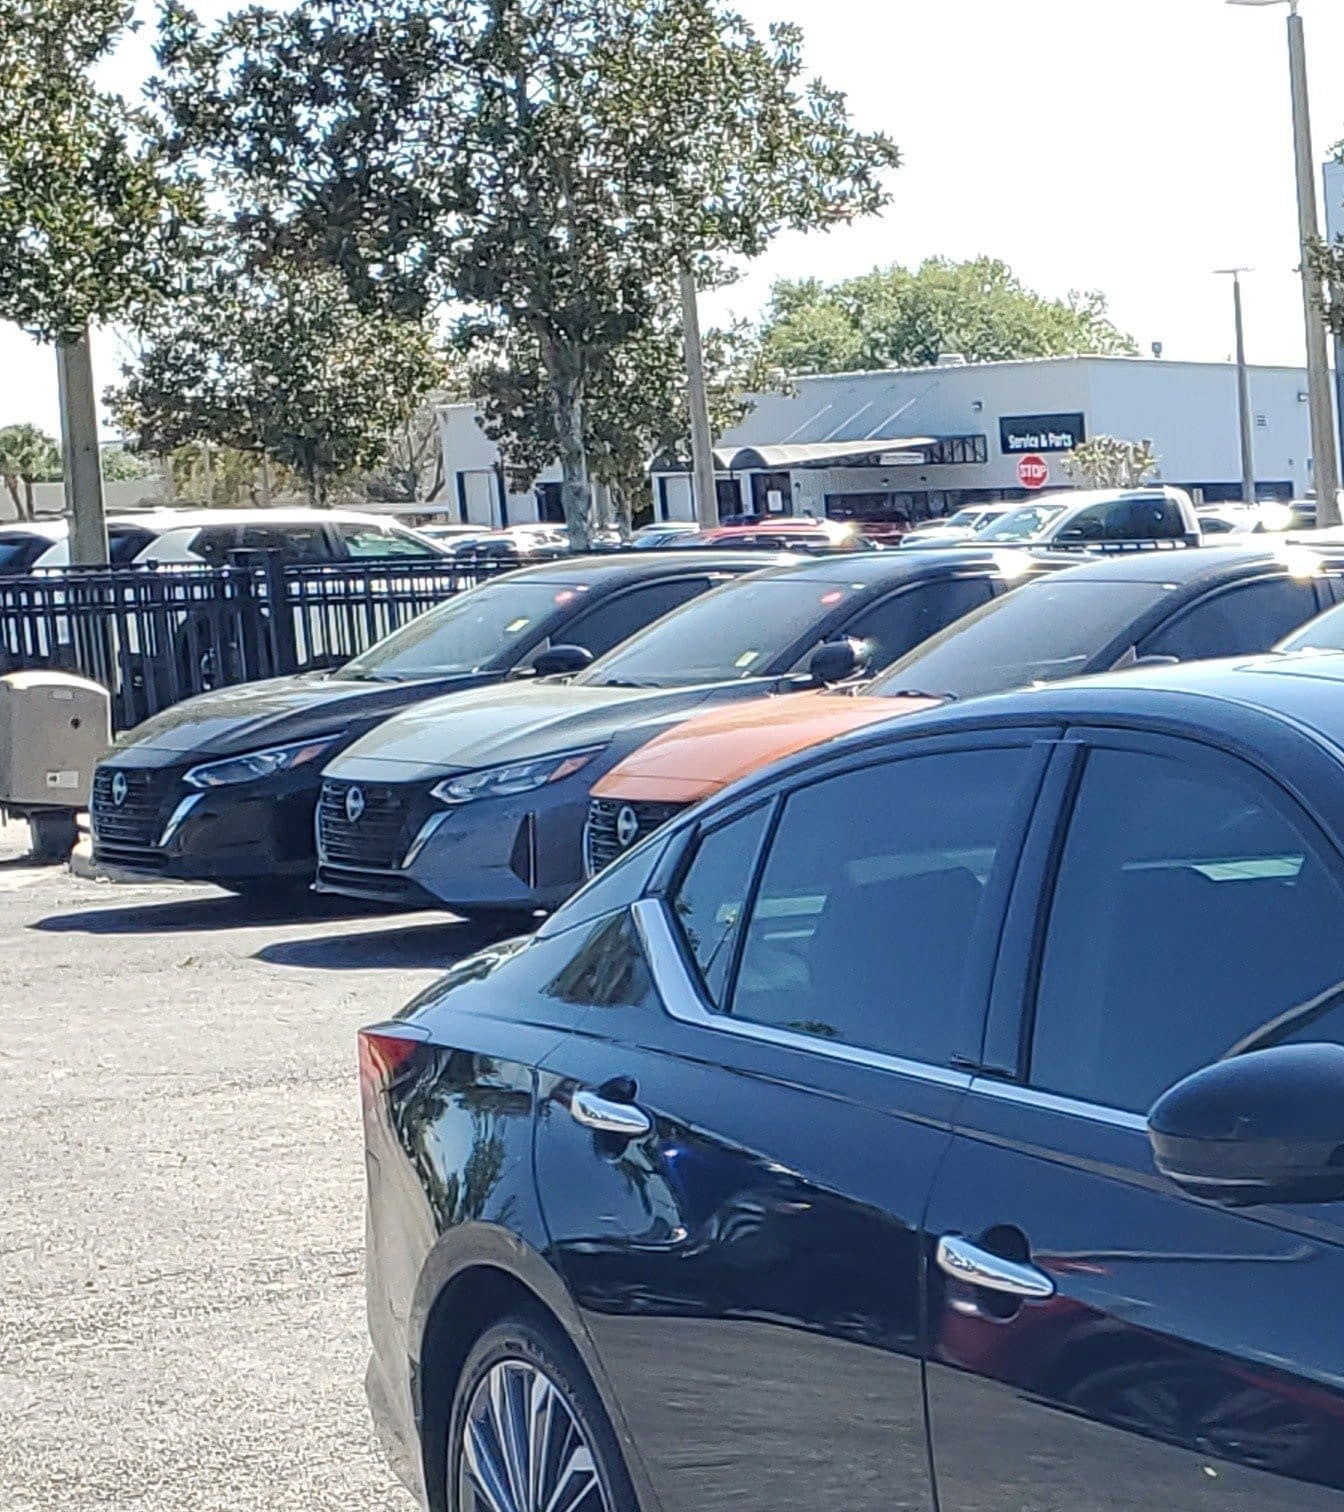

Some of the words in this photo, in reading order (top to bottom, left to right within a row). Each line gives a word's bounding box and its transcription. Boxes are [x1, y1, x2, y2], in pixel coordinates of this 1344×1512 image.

[1008, 434, 1038, 449] Service
[1040, 433, 1047, 448] &
[1048, 432, 1072, 447] Parts
[1019, 464, 1047, 478] STOP
